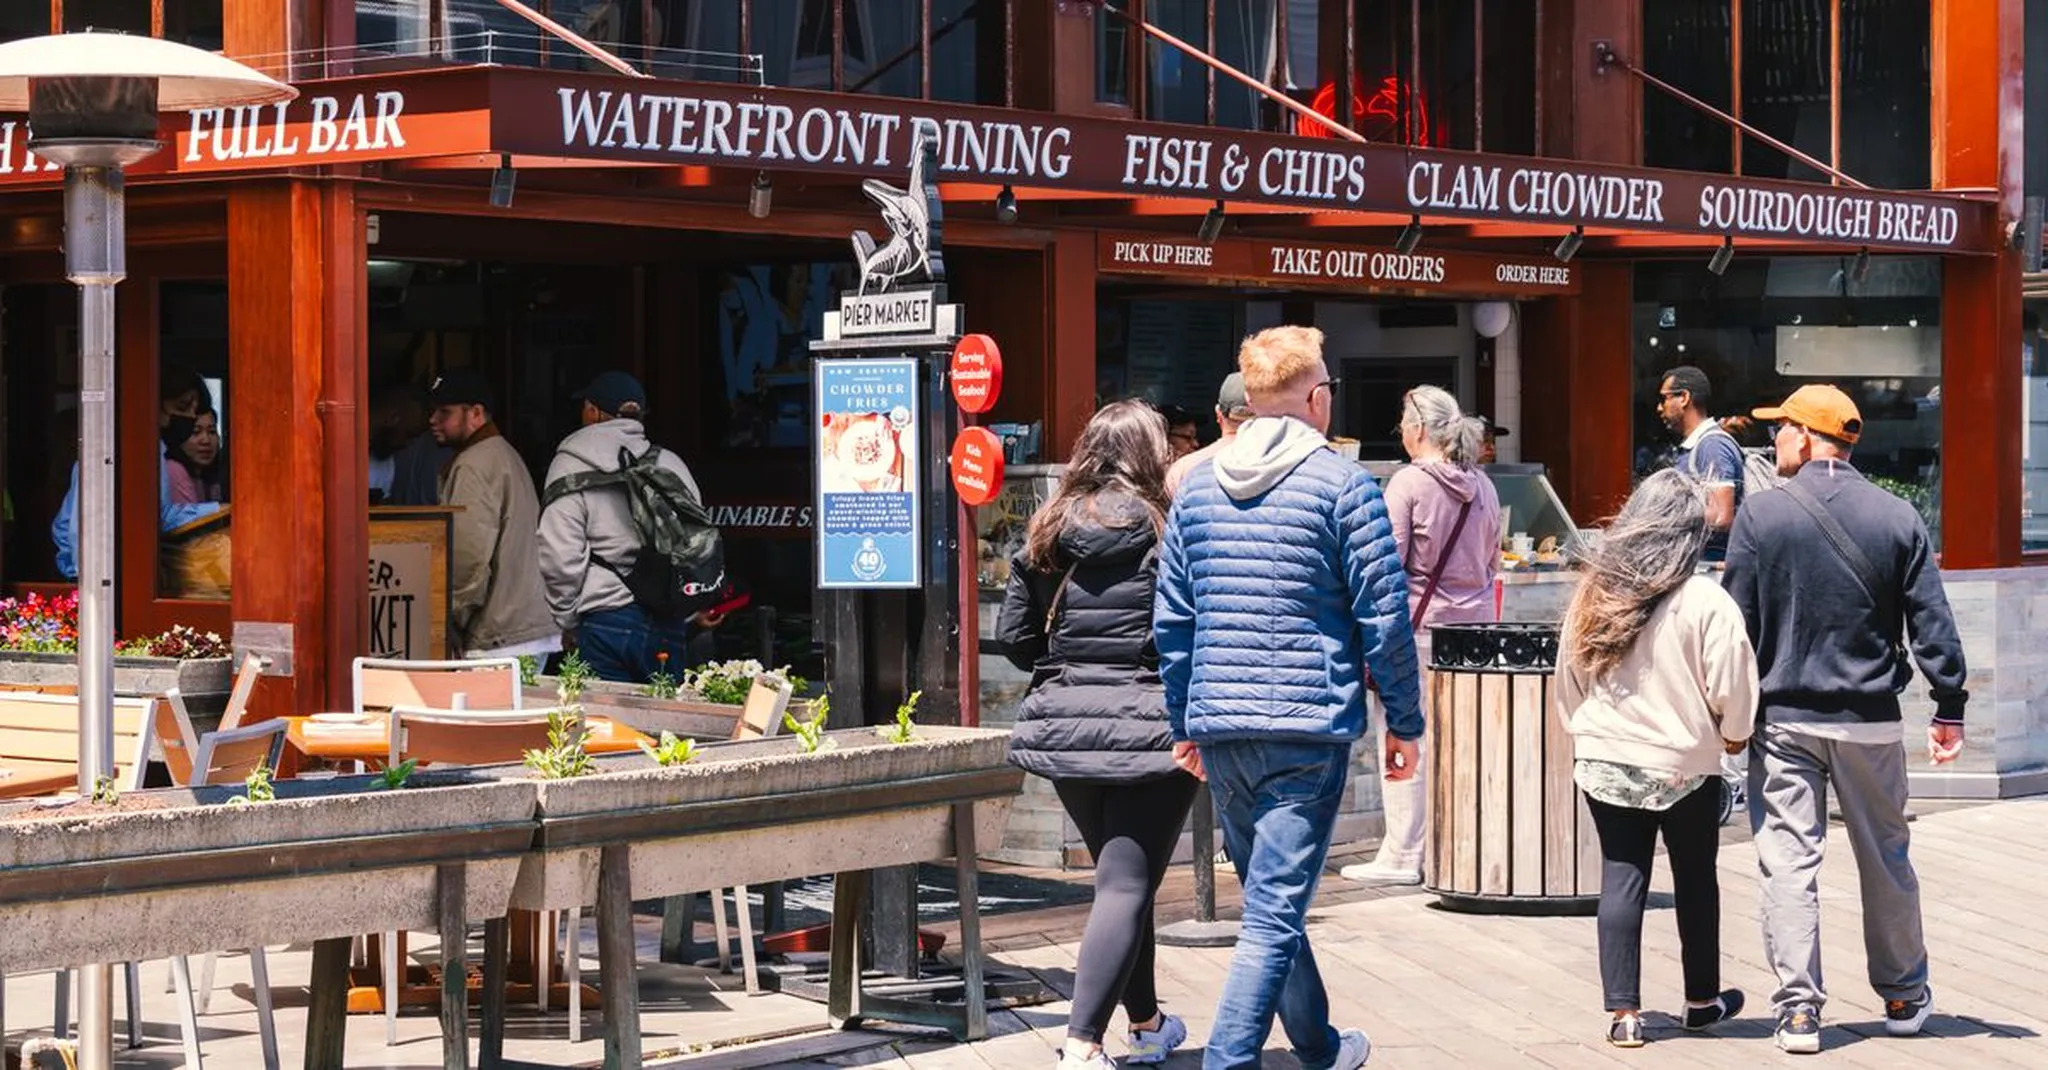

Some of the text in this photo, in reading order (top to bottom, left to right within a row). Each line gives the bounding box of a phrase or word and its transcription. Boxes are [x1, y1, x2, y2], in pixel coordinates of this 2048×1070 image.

[184, 91, 406, 164] FULL BAR
[557, 87, 1072, 180] WATERFRONT DINING
[1122, 134, 1366, 202] FISH & CHIPS
[1407, 161, 1665, 223] CLAM CHOWDER
[1699, 184, 1958, 245] SOURDOUGH BREAD
[1114, 241, 1213, 266] PICK UP HERE
[1271, 247, 1445, 283] TAKE OUT ORDERS
[1496, 264, 1570, 285] ORDER HERE
[844, 299, 929, 327] PIER MARKET
[958, 352, 985, 366] Serving
[952, 368, 991, 380] Sustainable
[830, 383, 905, 396] CHOWDER
[958, 384, 986, 396] Seafood
[847, 397, 889, 409] FRIES
[965, 443, 982, 458] Kids
[962, 458, 984, 475] Menu
[704, 505, 796, 527] AINABLE
[858, 551, 879, 566] 40
[370, 594, 415, 661] KET
